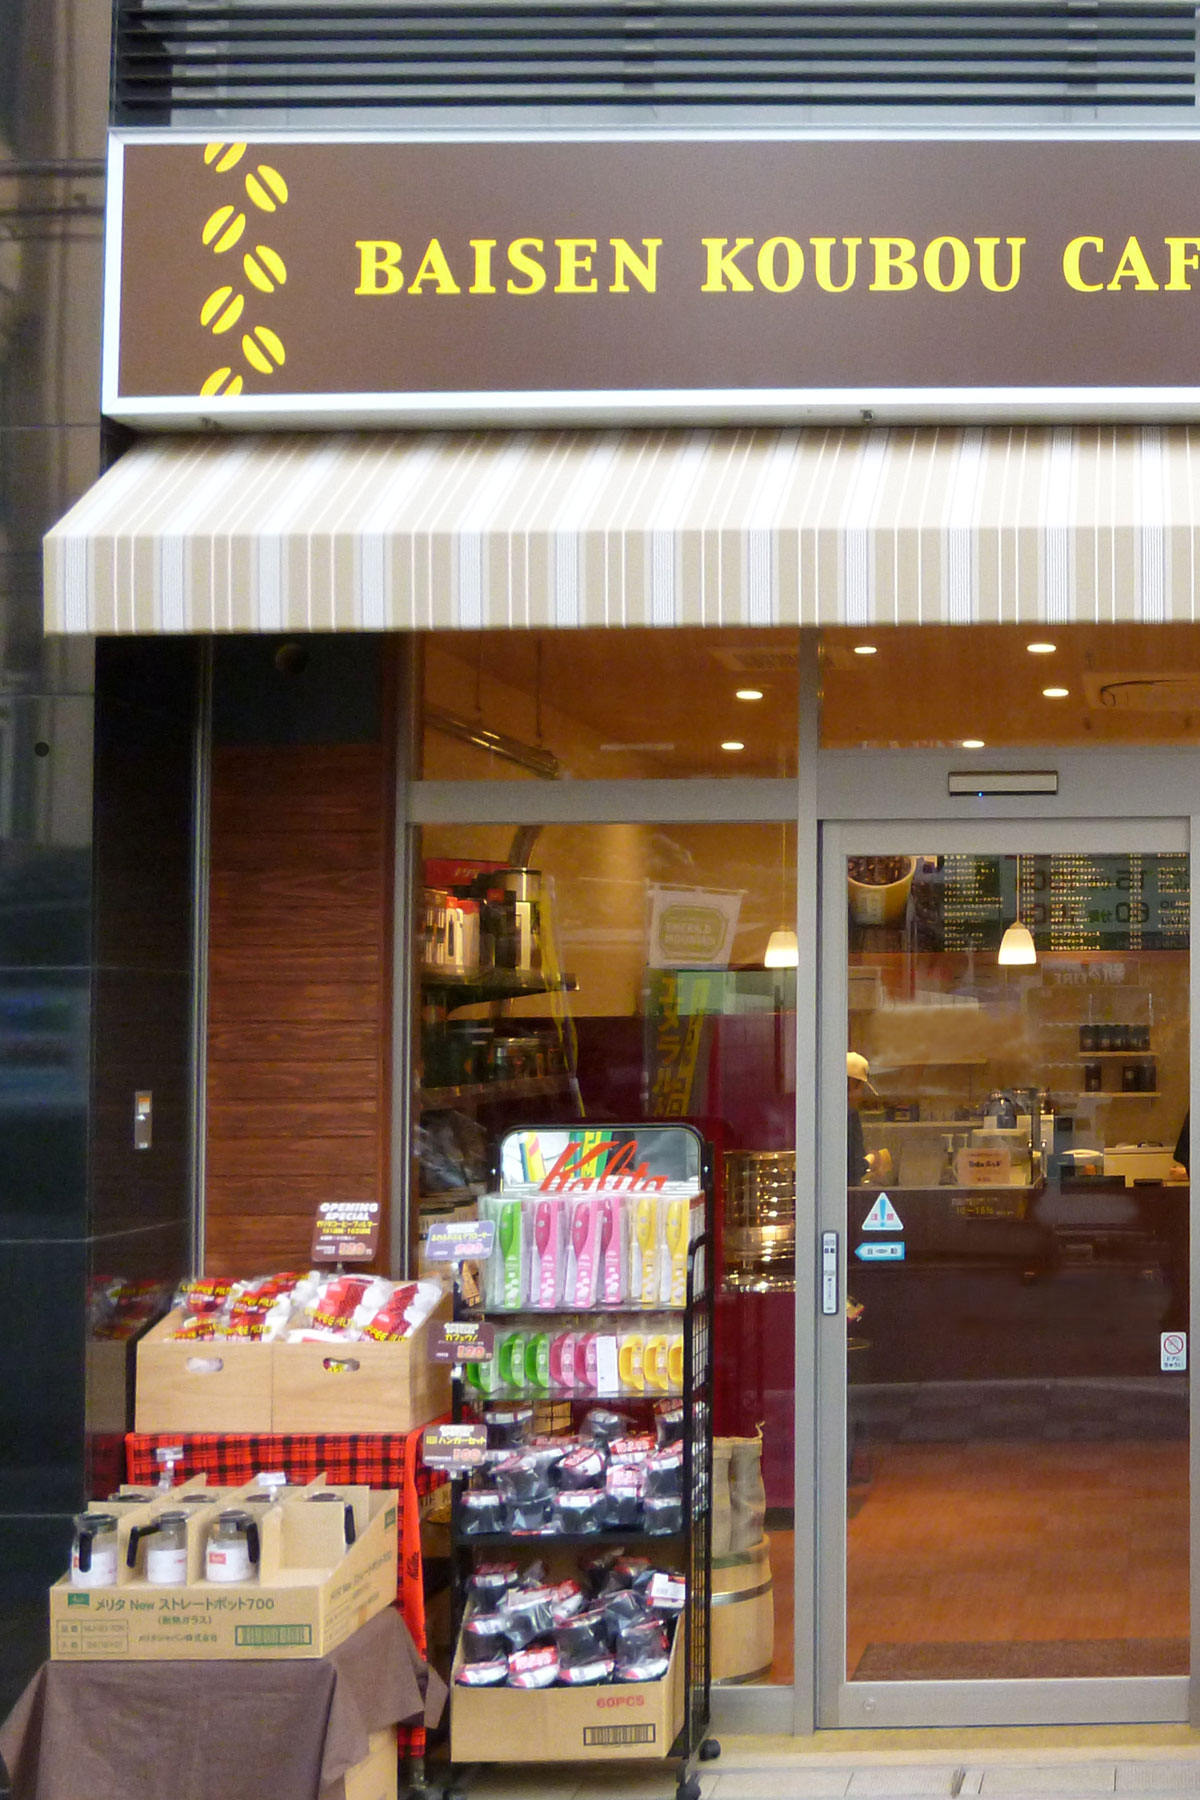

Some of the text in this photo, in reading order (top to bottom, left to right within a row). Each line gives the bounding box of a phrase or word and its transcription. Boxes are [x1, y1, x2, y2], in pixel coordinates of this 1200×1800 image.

[354, 237, 663, 296] BAISEN
[700, 235, 1027, 294] KOUBOU
[96, 1599, 126, 1611] メリタ
[130, 1599, 154, 1611] New
[596, 1695, 645, 1709] 60PCS
